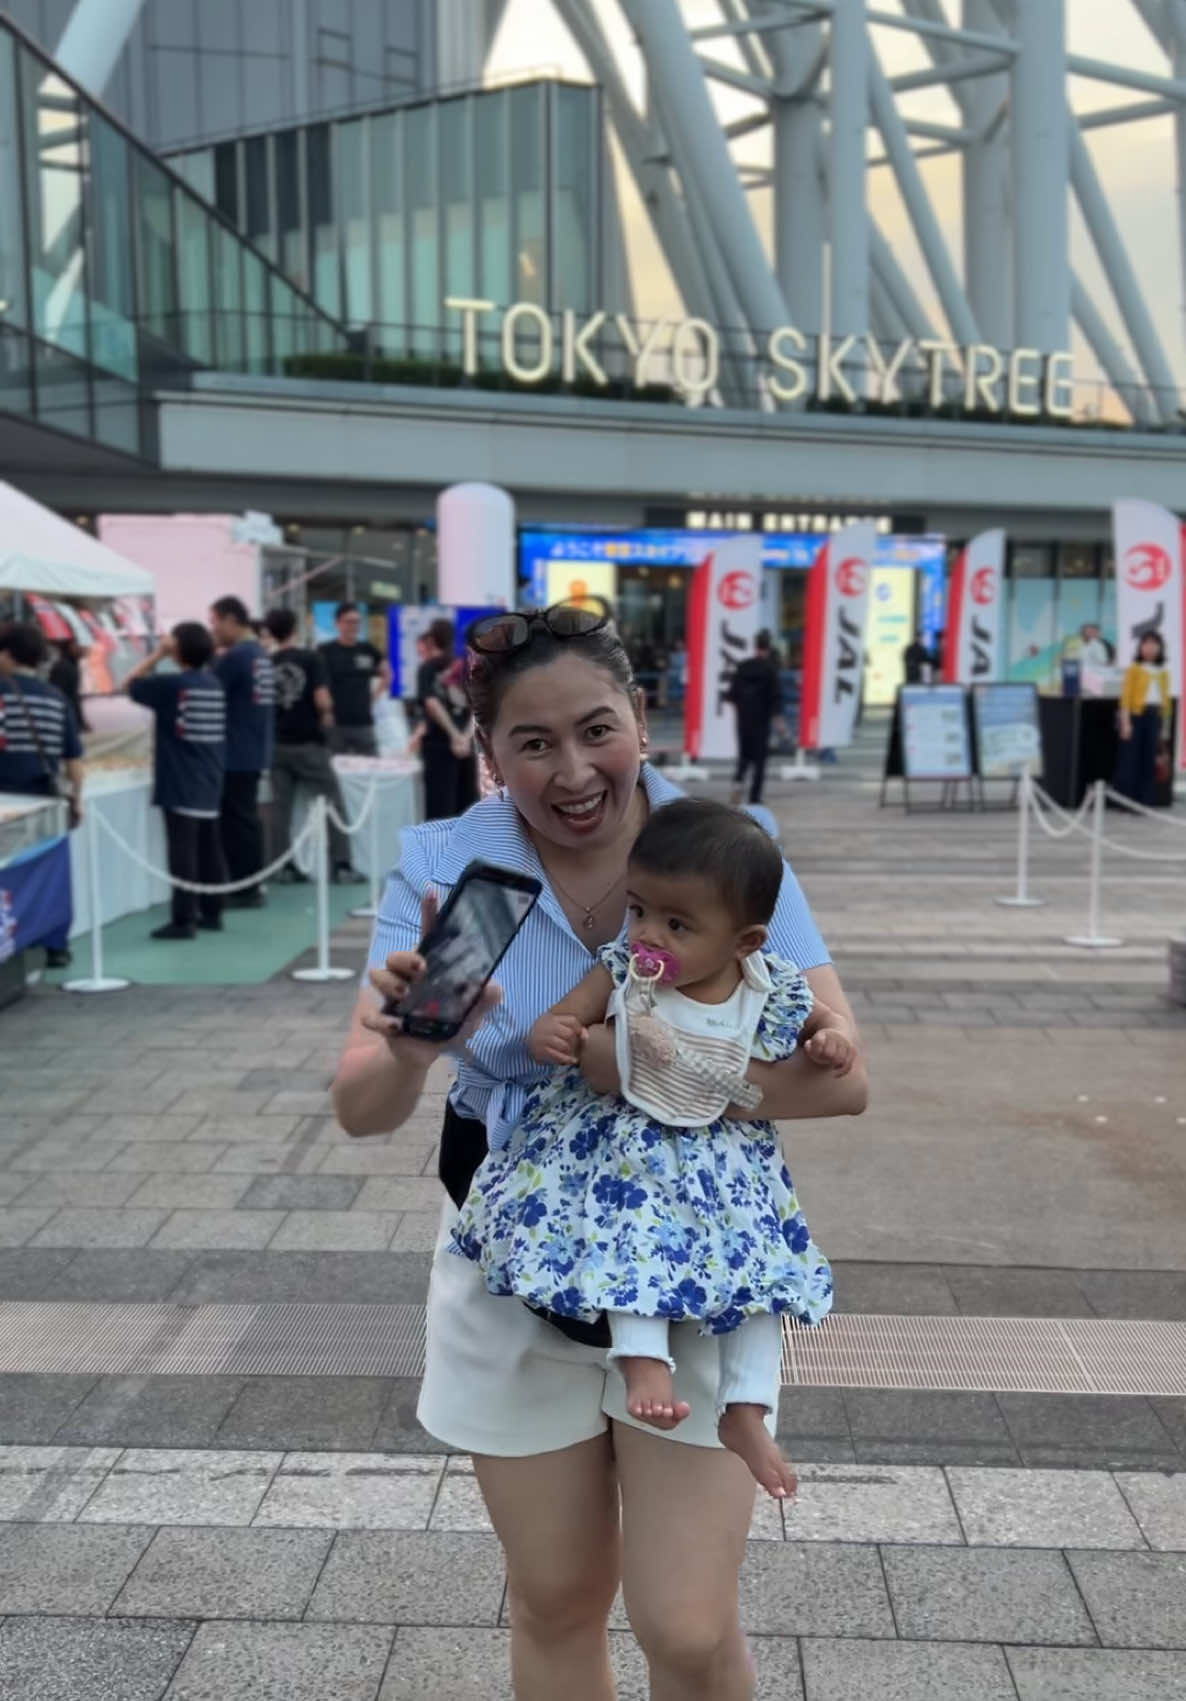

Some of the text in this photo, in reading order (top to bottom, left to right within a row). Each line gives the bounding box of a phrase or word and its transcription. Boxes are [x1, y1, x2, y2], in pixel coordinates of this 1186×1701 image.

[446, 298, 1076, 417] TOKYO SKYTREE
[834, 605, 862, 705] JAL
